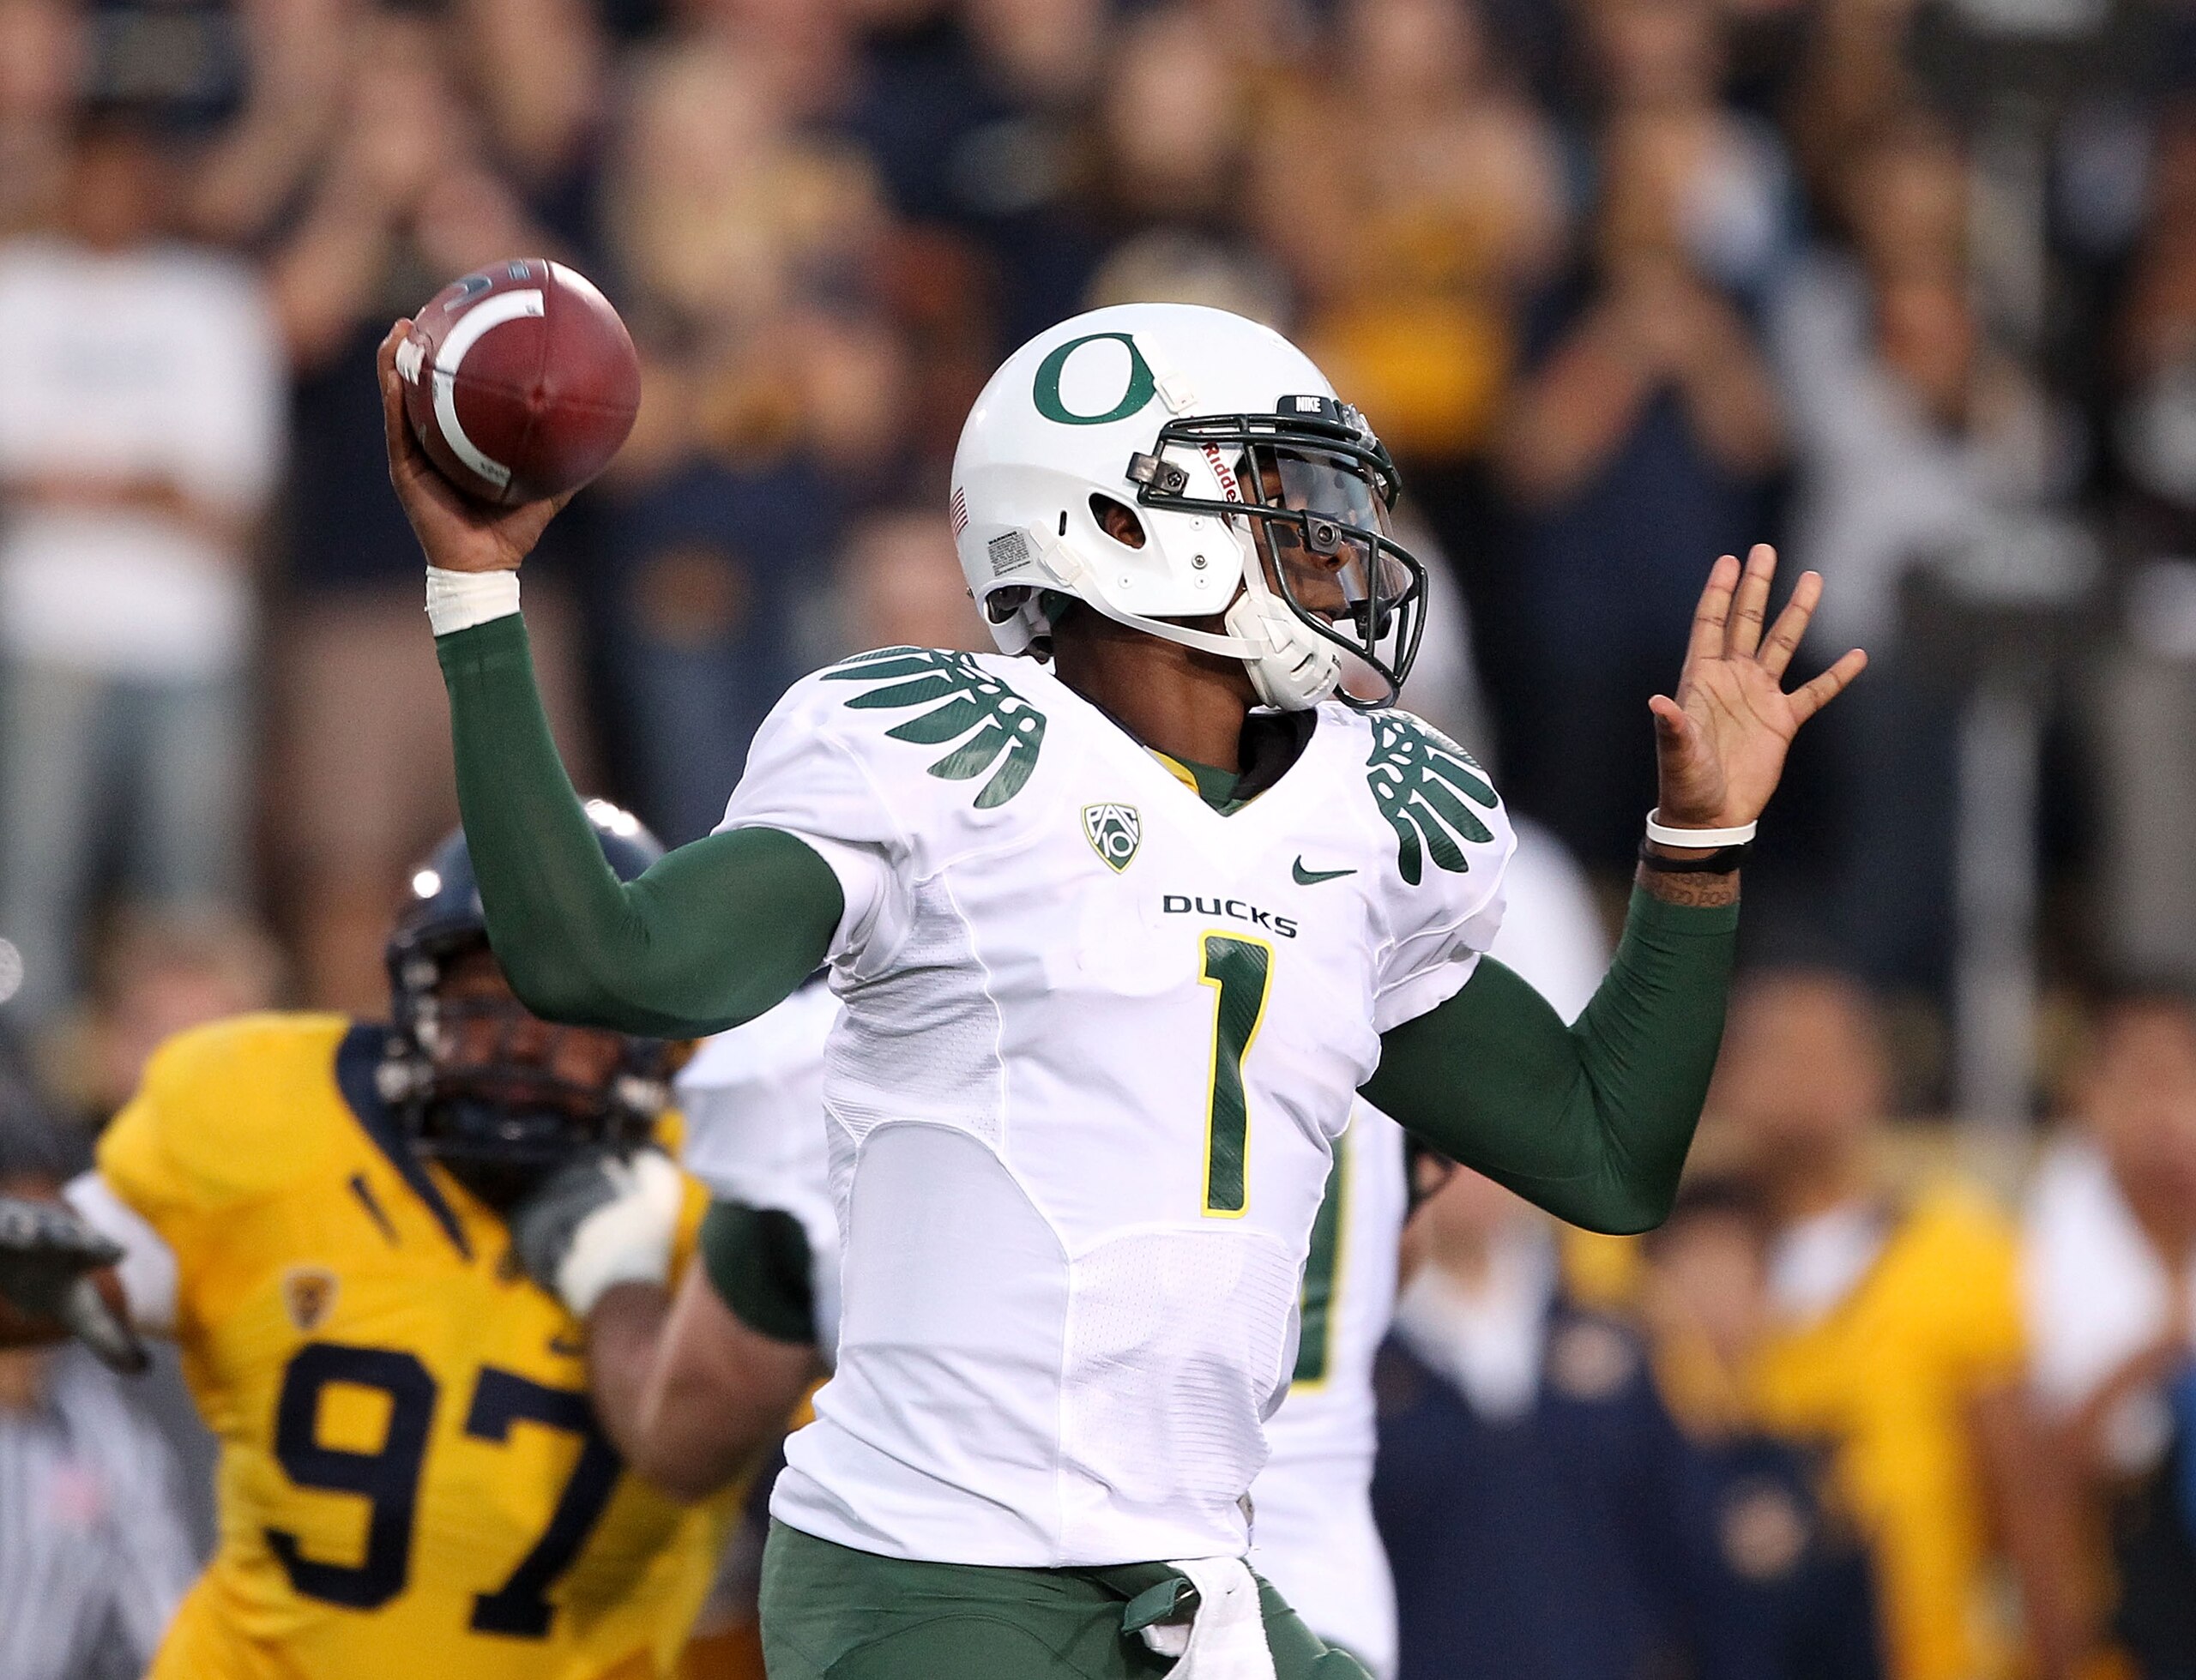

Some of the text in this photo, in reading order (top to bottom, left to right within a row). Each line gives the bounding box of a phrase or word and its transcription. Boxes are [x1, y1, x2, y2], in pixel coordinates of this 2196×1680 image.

[1033, 332, 1156, 425] O
[1295, 396, 1321, 412] NIKE
[1201, 442, 1241, 503] Ridde
[1163, 895, 1298, 939] DUCKS
[1199, 929, 1275, 1219] 1
[262, 1340, 626, 1641] 97
